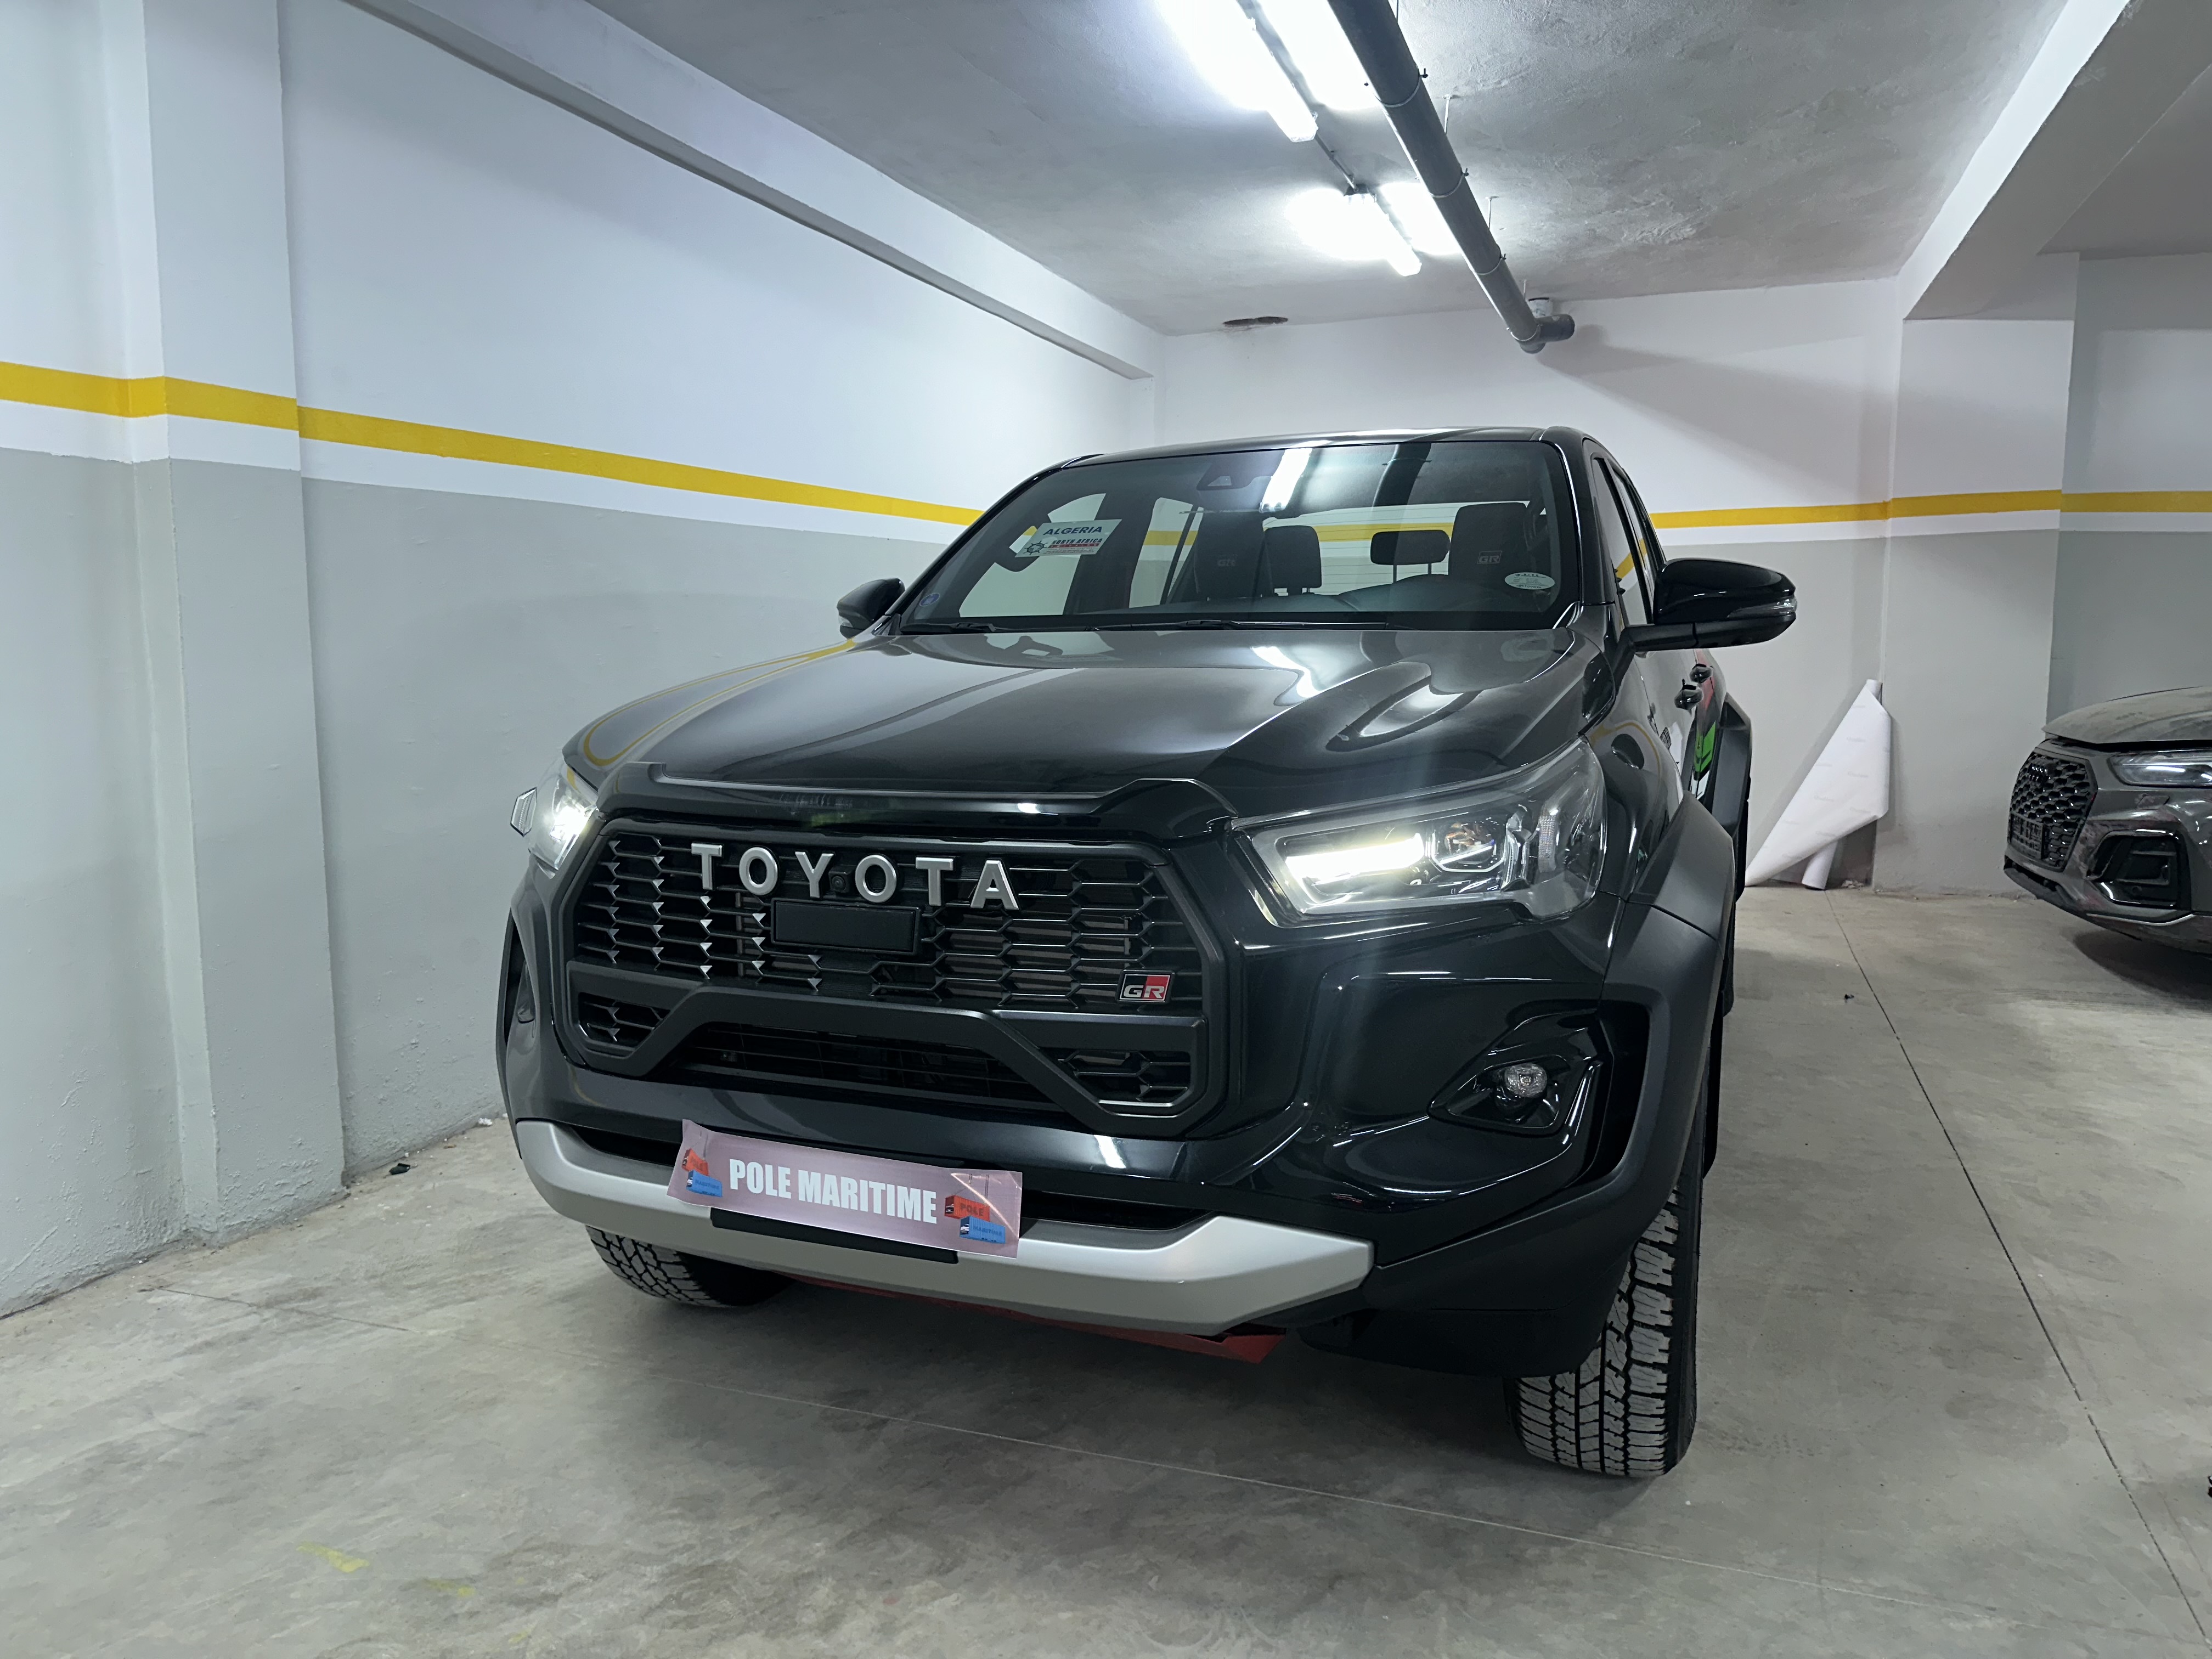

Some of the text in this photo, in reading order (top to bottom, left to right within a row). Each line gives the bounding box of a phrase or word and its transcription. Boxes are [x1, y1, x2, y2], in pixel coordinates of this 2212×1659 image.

[1043, 526, 1102, 535] ALGERIA
[691, 842, 1019, 911] TOYOTA
[1123, 985, 1165, 999] GR
[729, 1158, 938, 1224] POLE MARITIME
[960, 1203, 984, 1216] POLE
[973, 1225, 1002, 1236] MARITIME
